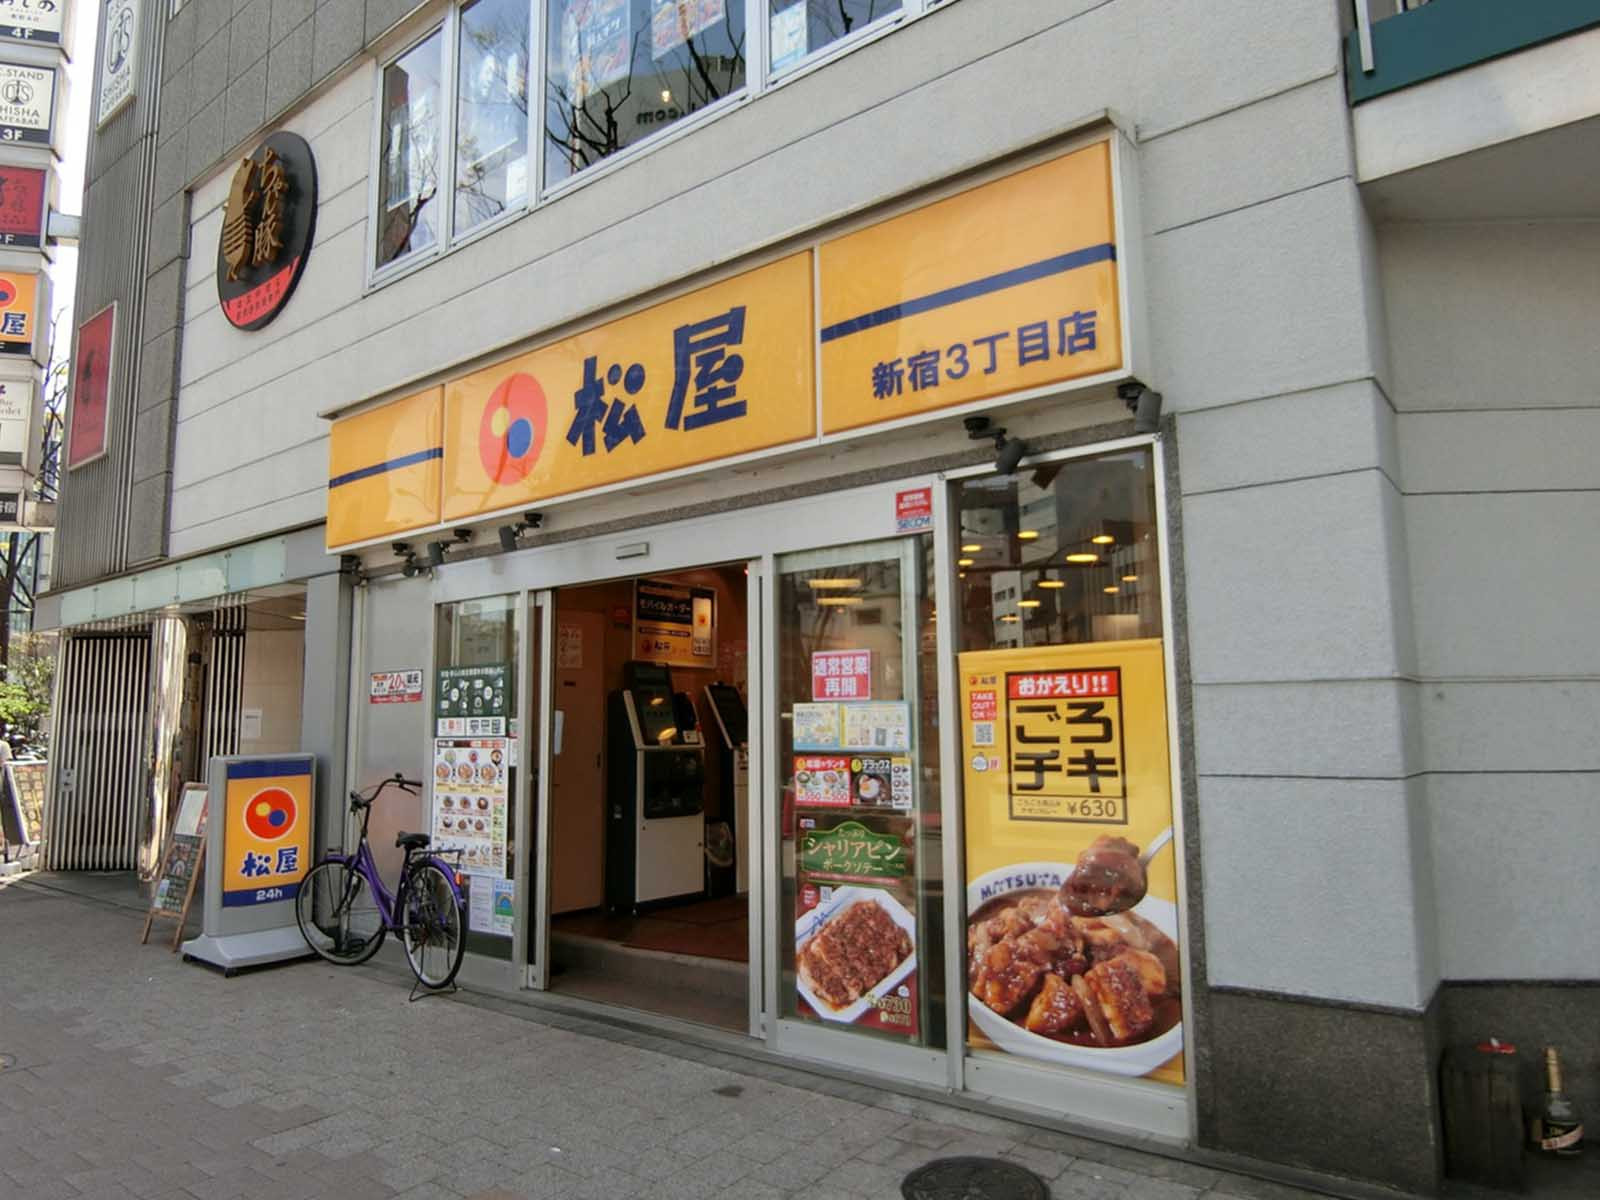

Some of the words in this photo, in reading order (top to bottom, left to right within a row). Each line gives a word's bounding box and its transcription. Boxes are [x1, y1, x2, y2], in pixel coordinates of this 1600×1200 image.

[11, 28, 33, 39] 4F
[0, 105, 40, 119] HISHA
[3, 128, 23, 140] 3F
[871, 309, 1098, 400] 新宿3丁目店
[566, 305, 748, 457] 松屋
[824, 676, 857, 697] 再開
[1017, 674, 1110, 696] おかえり!!
[1015, 701, 1114, 744] ごろ
[1013, 749, 1119, 793] チキ
[1066, 799, 1118, 818] ¥630
[807, 837, 901, 861] シャリアピン
[240, 845, 300, 878] 松屋
[255, 889, 284, 901] 24h
